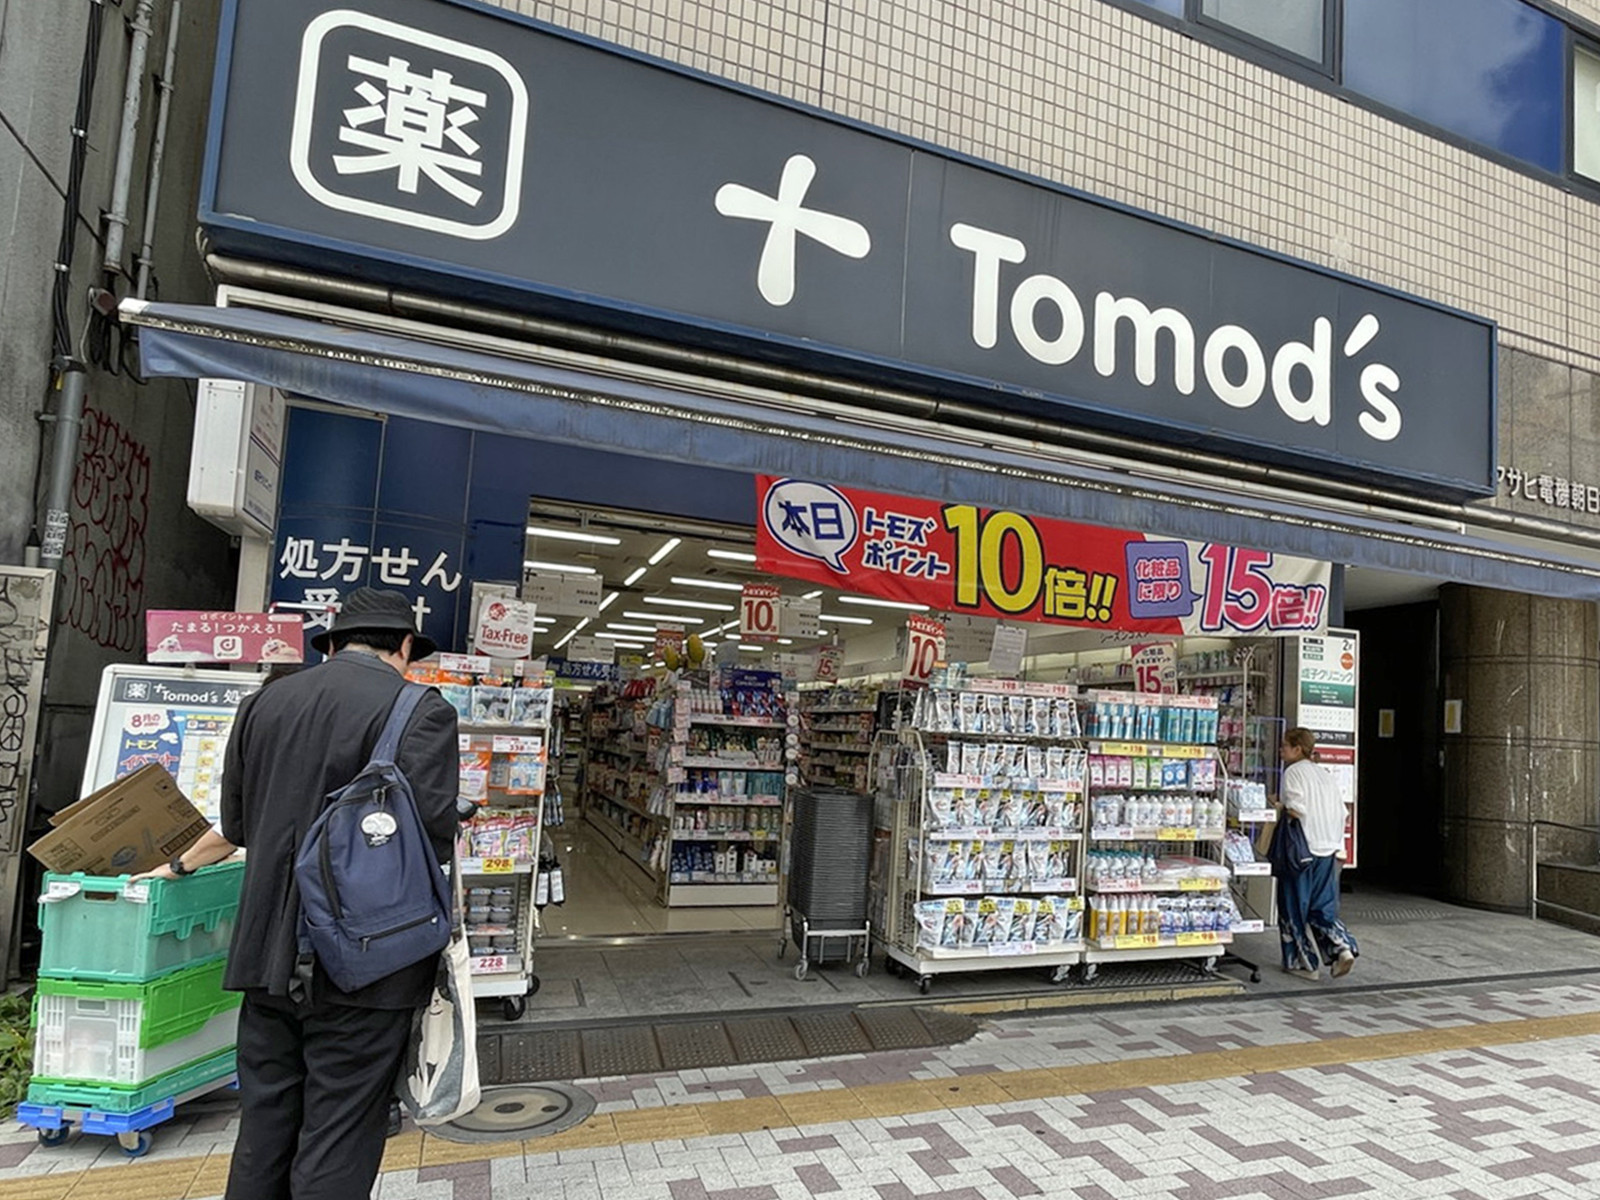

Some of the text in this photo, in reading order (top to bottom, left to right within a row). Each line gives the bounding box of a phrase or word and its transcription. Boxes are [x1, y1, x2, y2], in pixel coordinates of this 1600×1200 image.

[332, 55, 487, 207] 薬
[950, 223, 1402, 441] Tomod's
[778, 501, 845, 540] 本日
[864, 508, 938, 546] トモズ
[280, 536, 463, 592] 処方せん
[863, 541, 950, 578] ポイント
[1135, 557, 1182, 579] 化粧品
[1137, 582, 1182, 602] に限り
[481, 624, 529, 645] Tax-Free
[162, 690, 219, 704] Tomod's
[479, 957, 503, 968] 228
